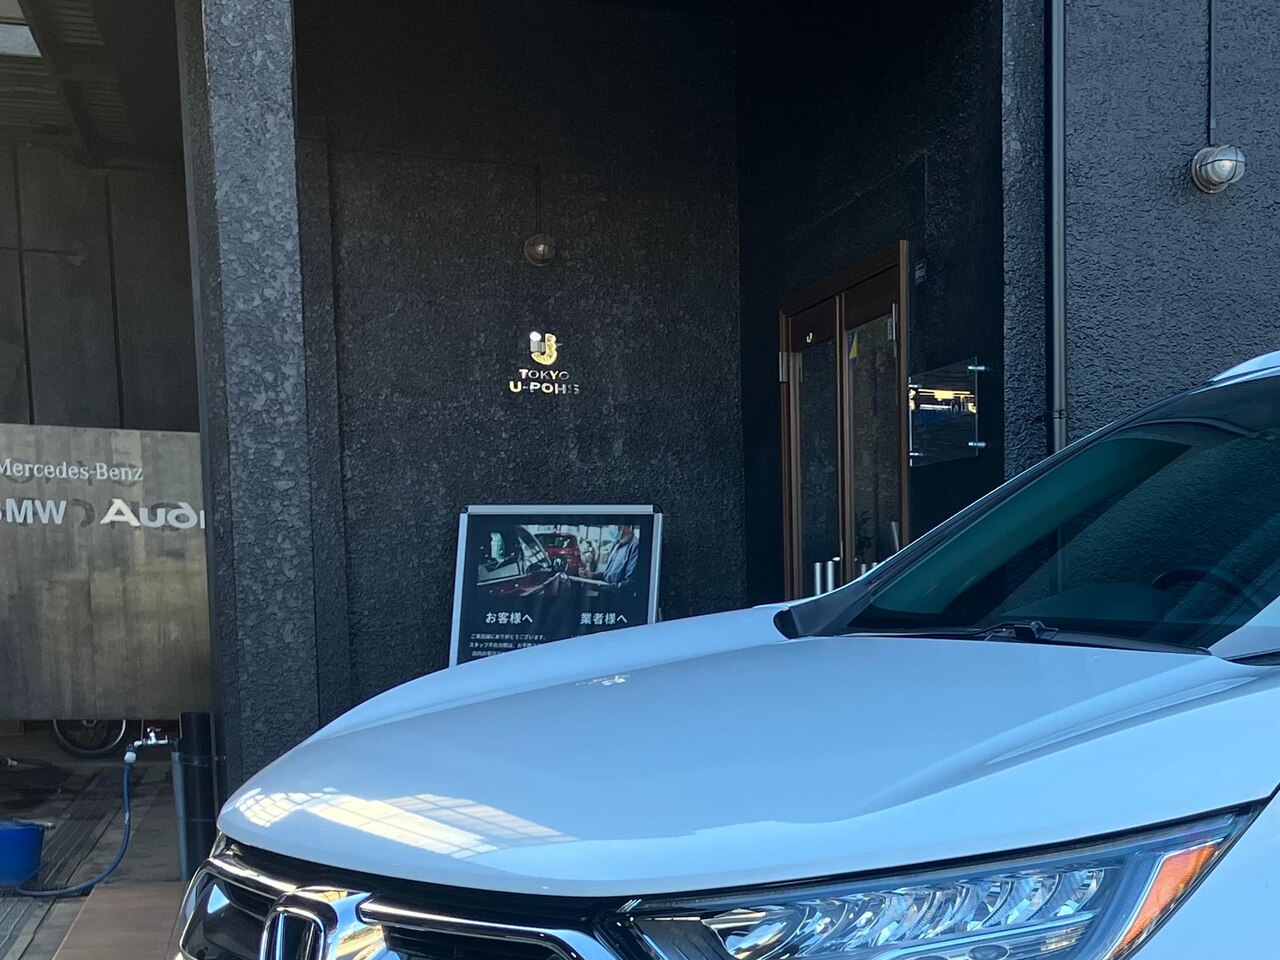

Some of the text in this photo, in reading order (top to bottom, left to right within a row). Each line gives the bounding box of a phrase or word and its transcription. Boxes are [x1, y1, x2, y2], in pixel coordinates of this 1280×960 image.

[518, 368, 570, 380] TOKYO
[0, 457, 144, 481] Mercedes-Benz
[0, 497, 67, 525] MW
[485, 611, 534, 625] お客様へ
[579, 612, 628, 625] 業者様へ
